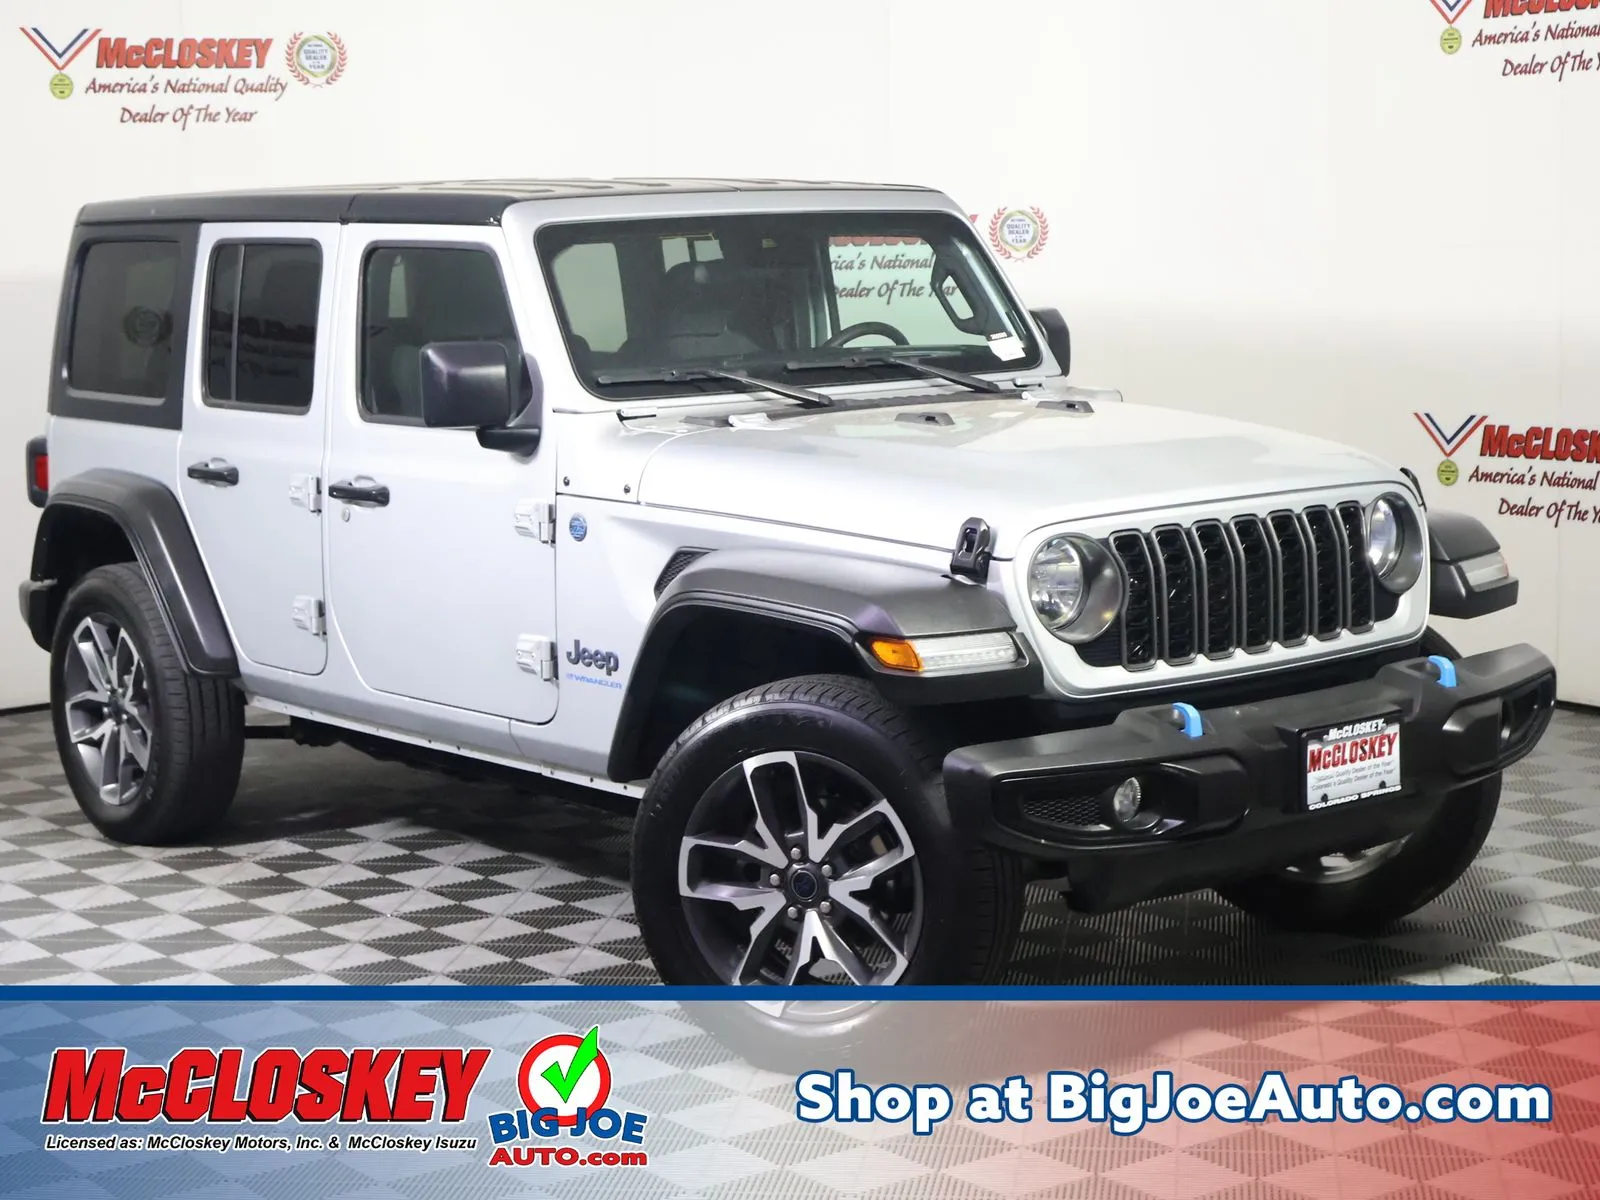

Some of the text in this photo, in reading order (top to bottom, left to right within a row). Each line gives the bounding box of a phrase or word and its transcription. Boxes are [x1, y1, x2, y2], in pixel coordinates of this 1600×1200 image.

[1472, 21, 1540, 47] America's
[96, 37, 273, 68] McCLOSKEY
[1502, 54, 1548, 77] Dealer
[1550, 51, 1571, 82] Of
[1571, 49, 1593, 72] The
[85, 75, 159, 94] America's
[164, 74, 231, 93] National
[234, 74, 288, 101] Quality
[120, 104, 258, 131] Dealer Of The Year
[830, 251, 935, 271] rica's National
[877, 279, 899, 305] Of
[900, 279, 925, 297] The
[1468, 465, 1536, 486] America's
[1540, 470, 1600, 490] National
[1498, 497, 1544, 517] Dealer
[1546, 499, 1567, 528] Of
[1567, 501, 1589, 522] The
[566, 639, 619, 676] Jeep
[1308, 732, 1398, 773] McCLOSKEY
[1309, 785, 1402, 810] COLORADO SPRINGS
